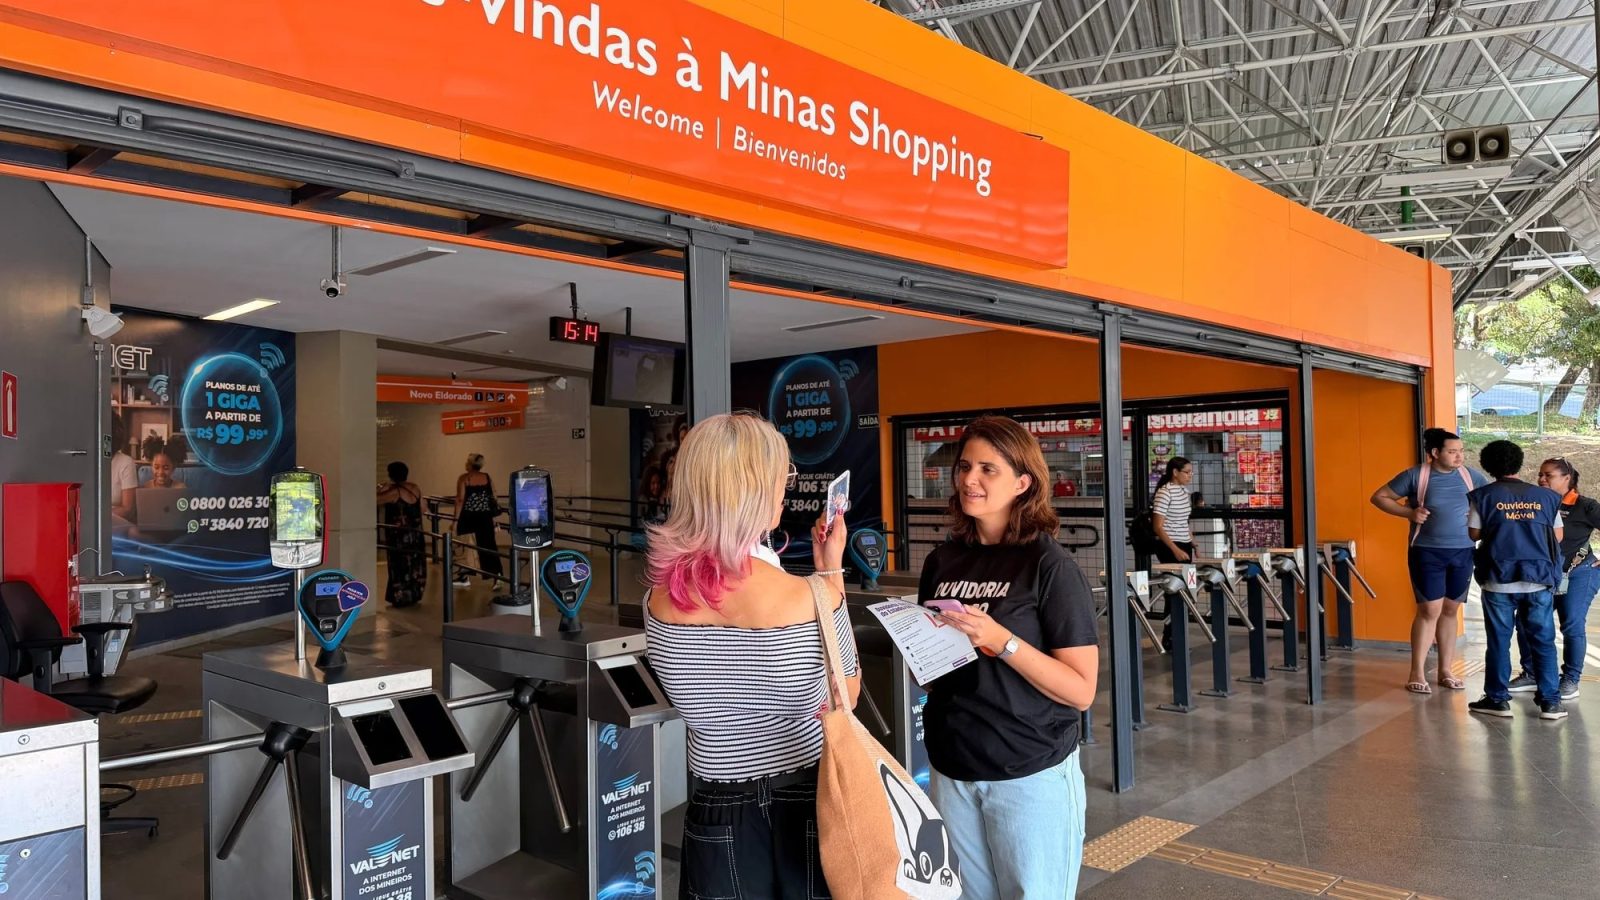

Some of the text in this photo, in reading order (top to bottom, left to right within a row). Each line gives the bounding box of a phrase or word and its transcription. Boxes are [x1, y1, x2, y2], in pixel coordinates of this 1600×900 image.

[420, 0, 992, 197] vindas à Minas Shopping
[592, 80, 704, 139] Welcome
[733, 125, 846, 180] Bienvenidos
[564, 321, 598, 342] 15:14
[205, 381, 261, 392] PLANOS DE ATÉ
[785, 380, 831, 391] PLANOS DE ATÉ
[205, 391, 260, 410] 1 GIGA
[409, 389, 473, 401] Novo Eldorado
[785, 390, 831, 407] 1 GIGA
[205, 411, 261, 422] A PARTIR DE
[786, 407, 831, 418] A PARTIR DE
[859, 416, 879, 426] SAÍDA
[196, 426, 214, 440] R$
[798, 481, 818, 493] 106
[189, 497, 226, 510] 0800
[228, 496, 253, 509] 026
[790, 499, 820, 512] 3840
[1496, 501, 1542, 511] Ouvidoria
[1505, 510, 1535, 520] Móvel
[209, 517, 245, 531] 3840
[246, 516, 270, 529] 720
[934, 580, 1011, 599] OUVIDORIA
[616, 799, 641, 811] INTERNET
[608, 805, 645, 822] DOS MINEIROS
[617, 821, 645, 838] 106 38
[370, 866, 407, 883] INTERNET
[358, 873, 413, 896] DOS MINEIROS
